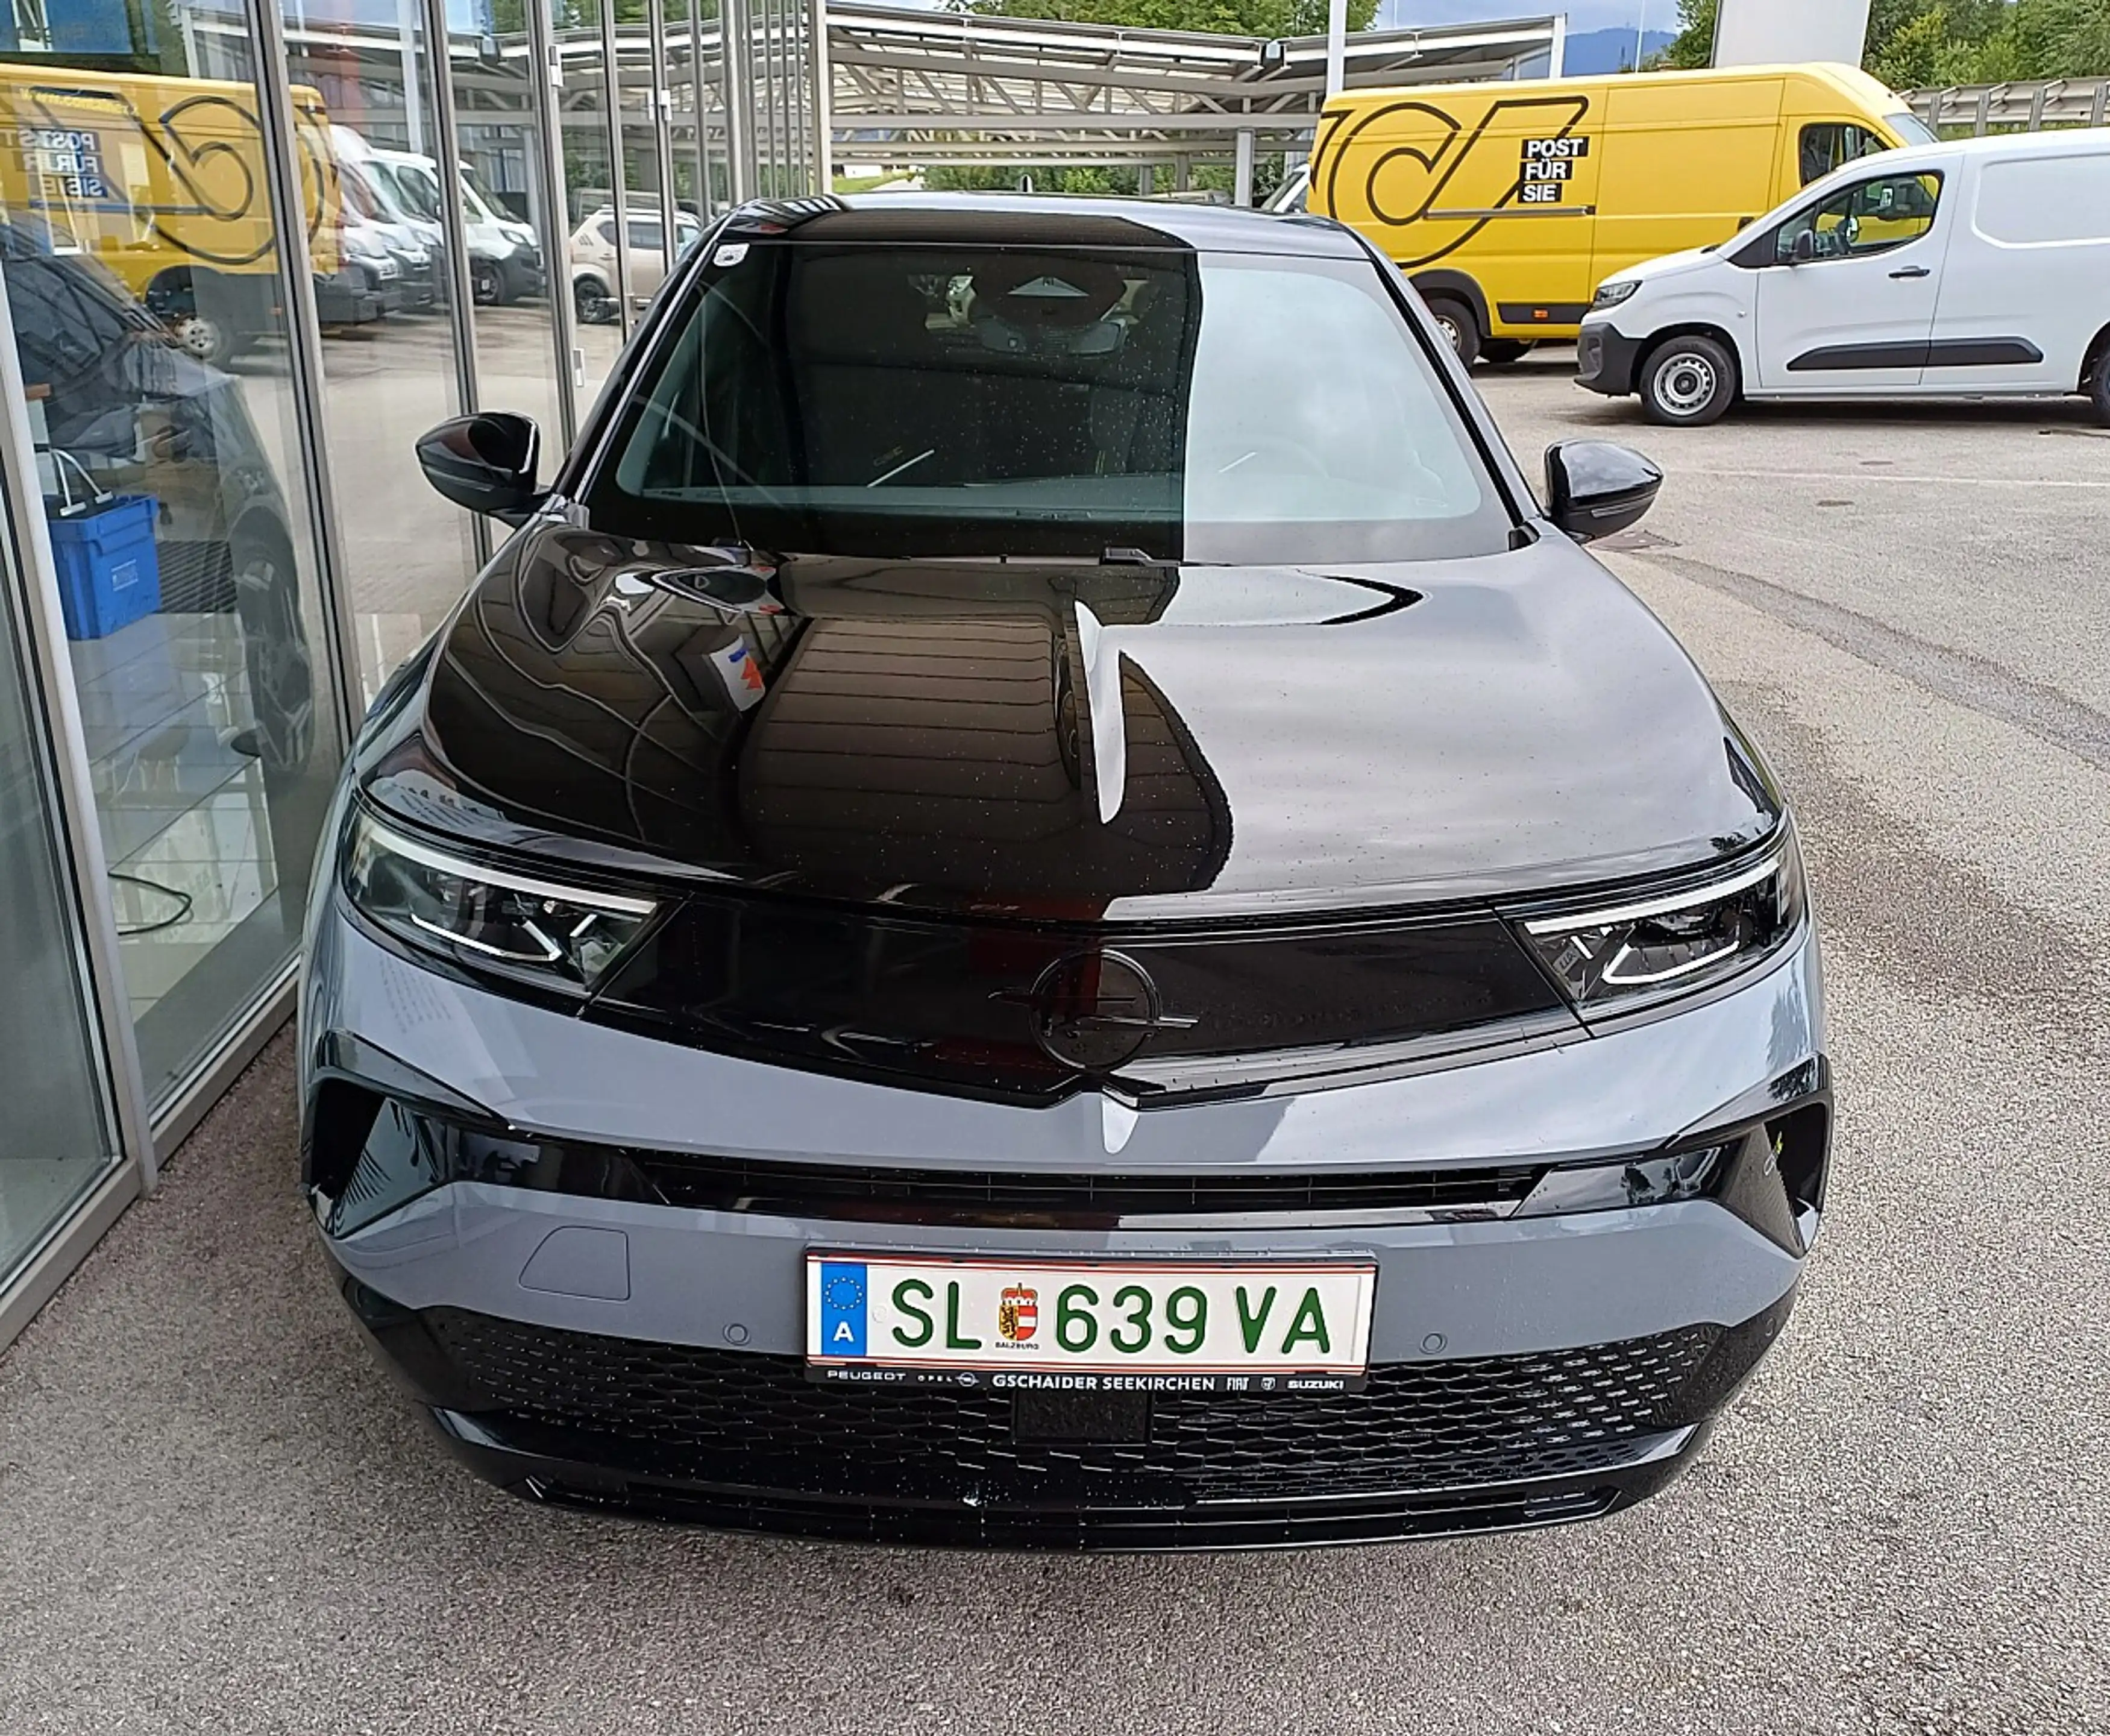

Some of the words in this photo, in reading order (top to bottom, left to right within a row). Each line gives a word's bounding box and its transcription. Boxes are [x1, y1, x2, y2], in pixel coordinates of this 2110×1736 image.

[1528, 139, 1583, 156] POST
[1526, 159, 1566, 180] FÜR
[1524, 185, 1556, 201] SIE
[893, 1280, 981, 1348] SL
[1057, 1286, 1206, 1353] 639
[1237, 1288, 1329, 1353] VA
[834, 1322, 853, 1341] A
[828, 1371, 906, 1380] PEUGEOT
[993, 1375, 1097, 1389] GSCHAIDER
[1103, 1377, 1214, 1390] SEEKIRCHEN
[1227, 1377, 1249, 1390] FIAT
[1288, 1380, 1343, 1389] SUZUKI
